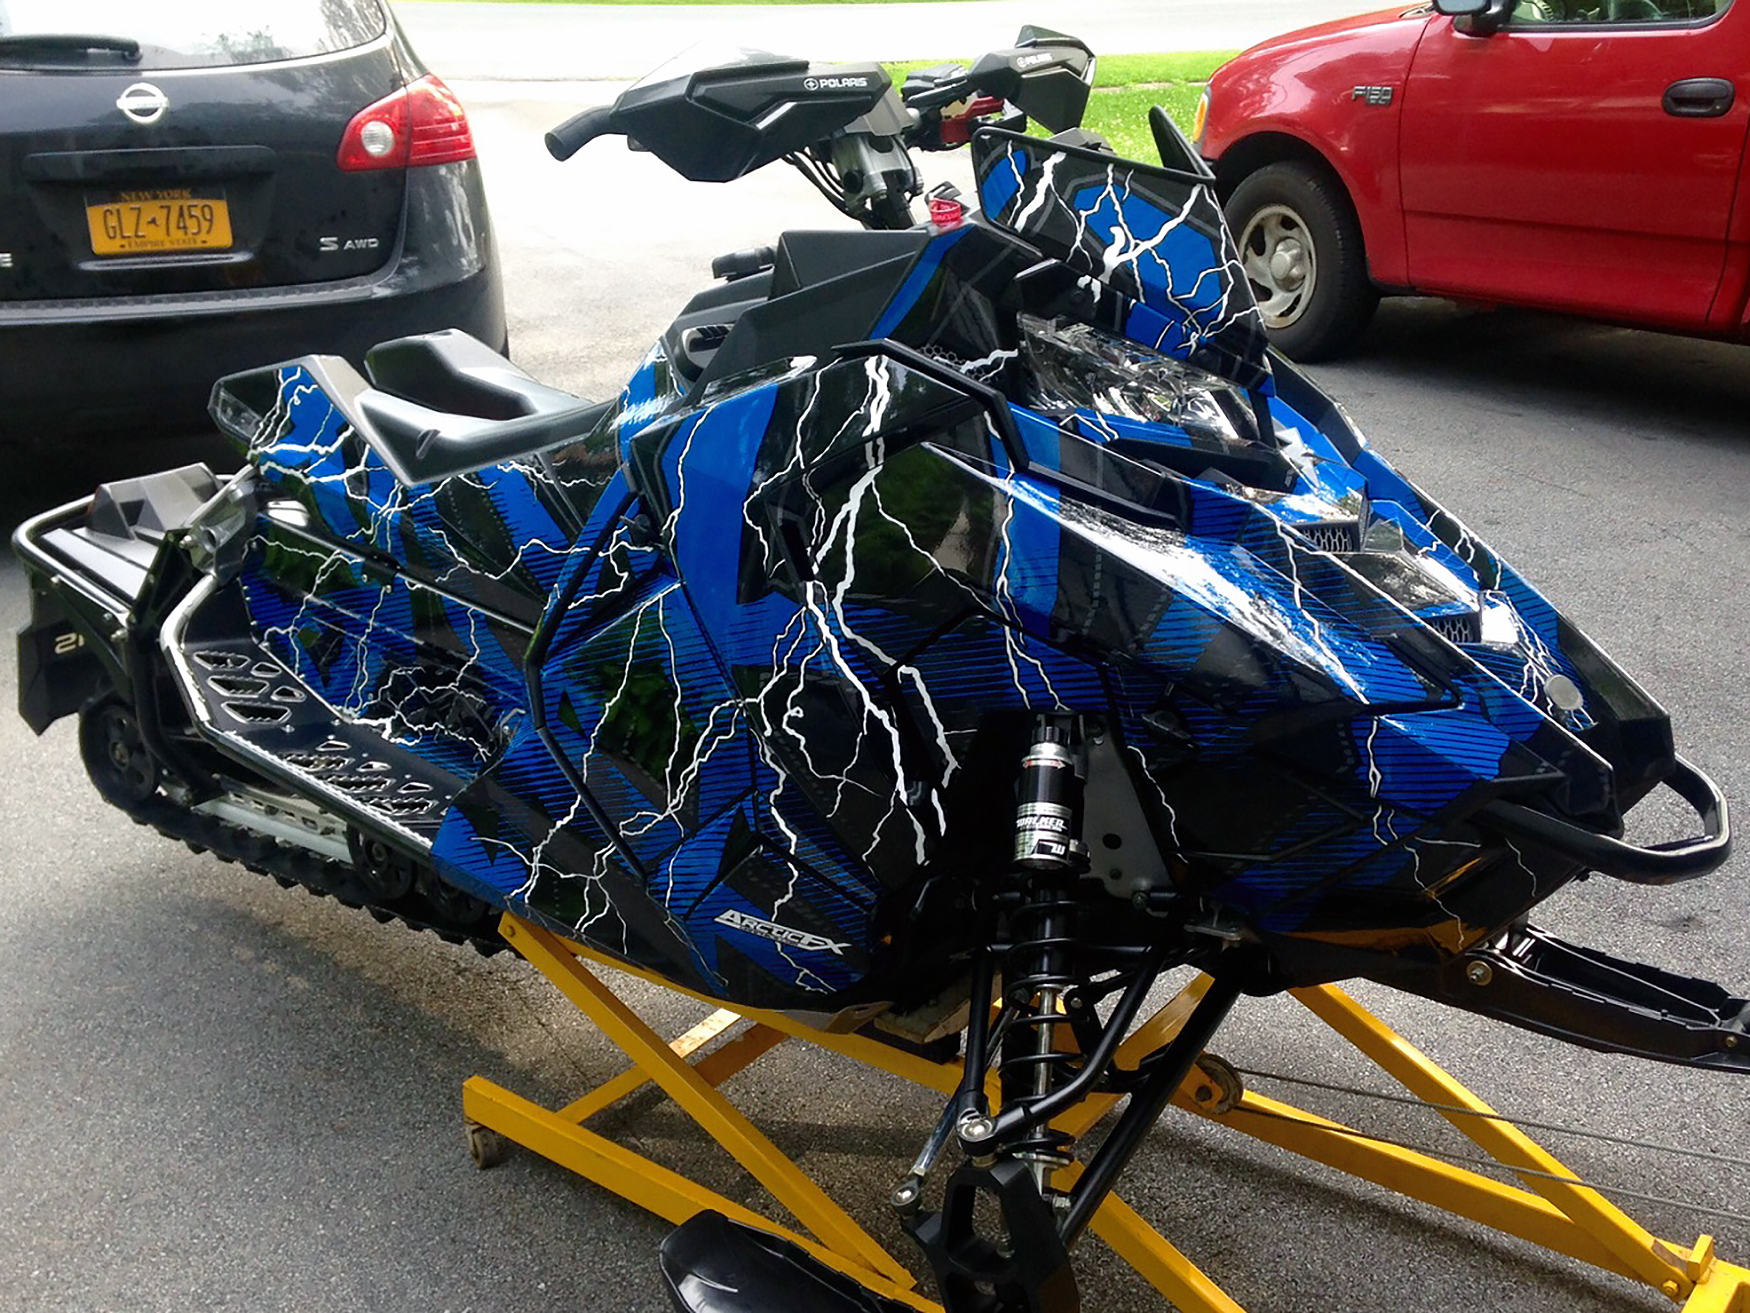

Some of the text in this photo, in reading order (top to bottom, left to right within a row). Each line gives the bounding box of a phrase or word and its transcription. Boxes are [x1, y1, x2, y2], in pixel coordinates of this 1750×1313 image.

[820, 77, 868, 89] POLARIS
[320, 236, 379, 251] S AWD
